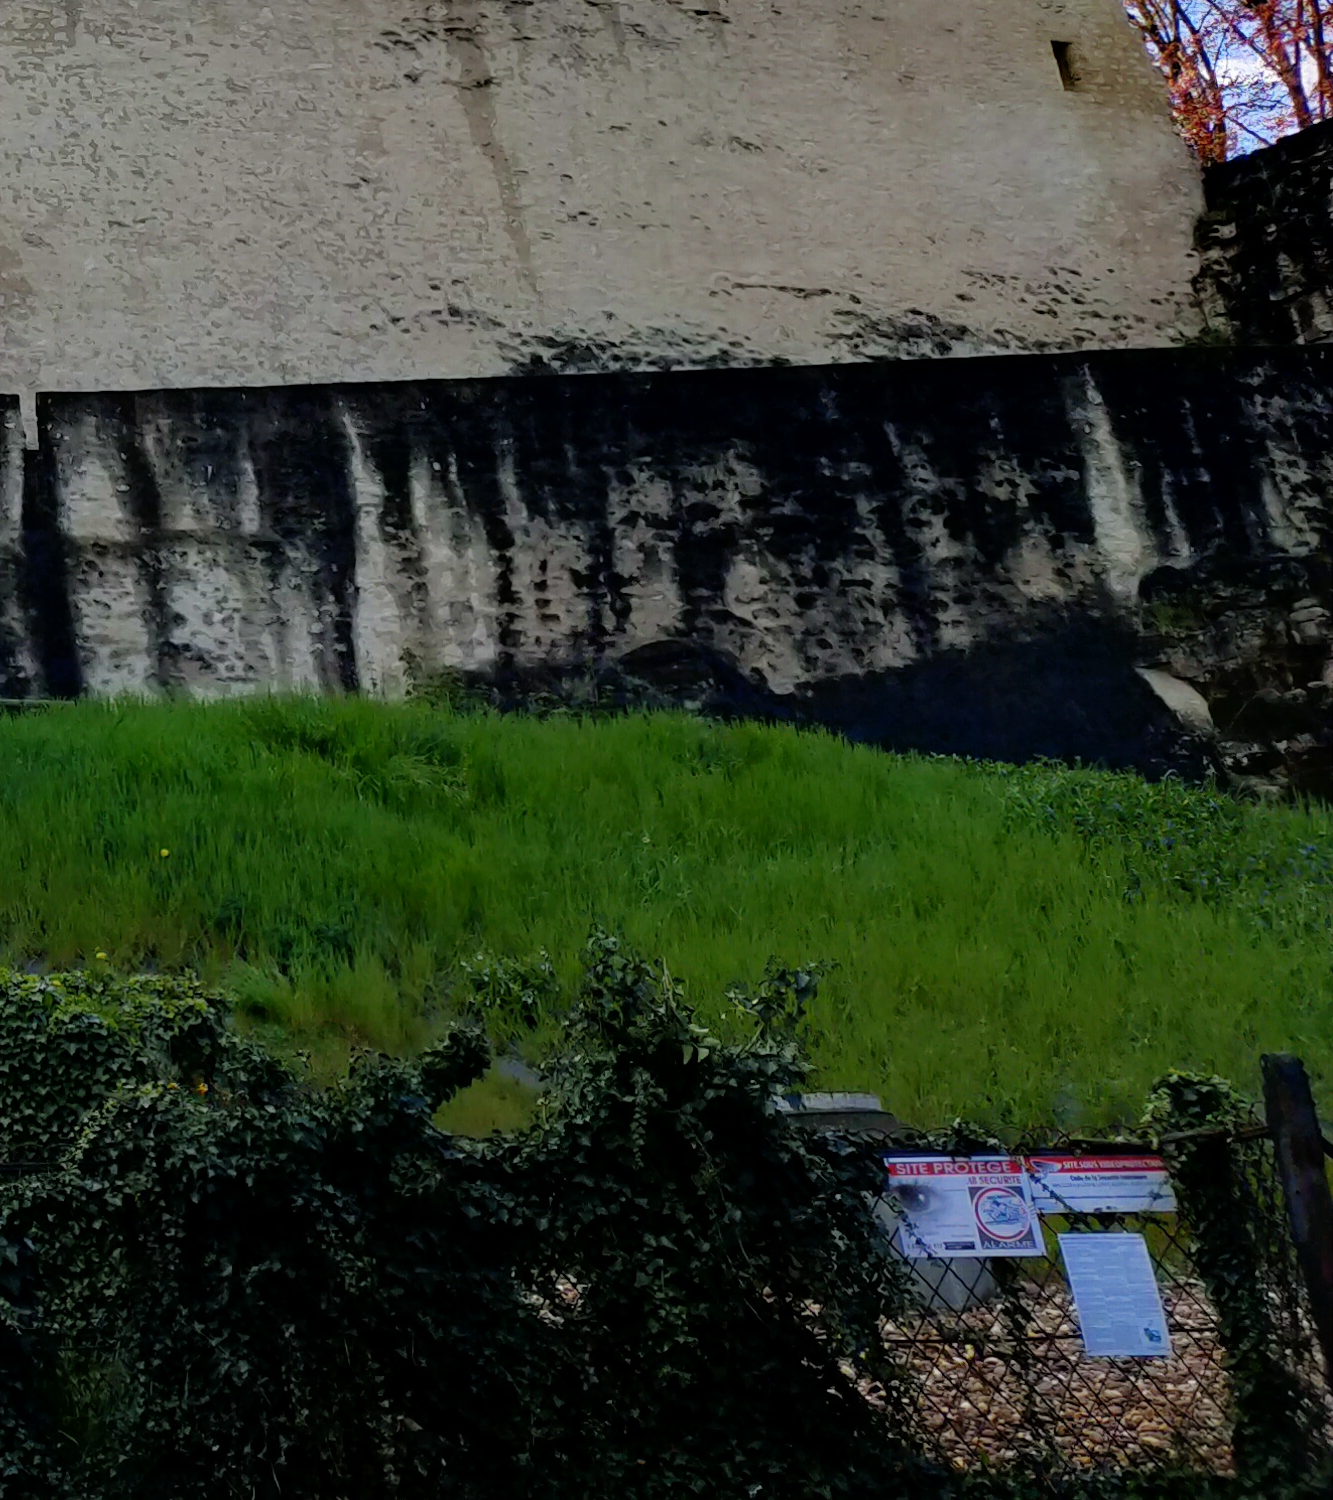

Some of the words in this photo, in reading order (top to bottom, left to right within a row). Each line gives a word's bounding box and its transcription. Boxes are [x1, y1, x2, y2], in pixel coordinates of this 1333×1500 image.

[896, 1162, 928, 1175] SITE
[933, 1161, 1011, 1174] PROTEGE
[1063, 1160, 1079, 1170] SITE
[1080, 1160, 1097, 1170] SOUS
[979, 1175, 1021, 1184] SECURITE
[984, 1240, 1034, 1249] ALARME
